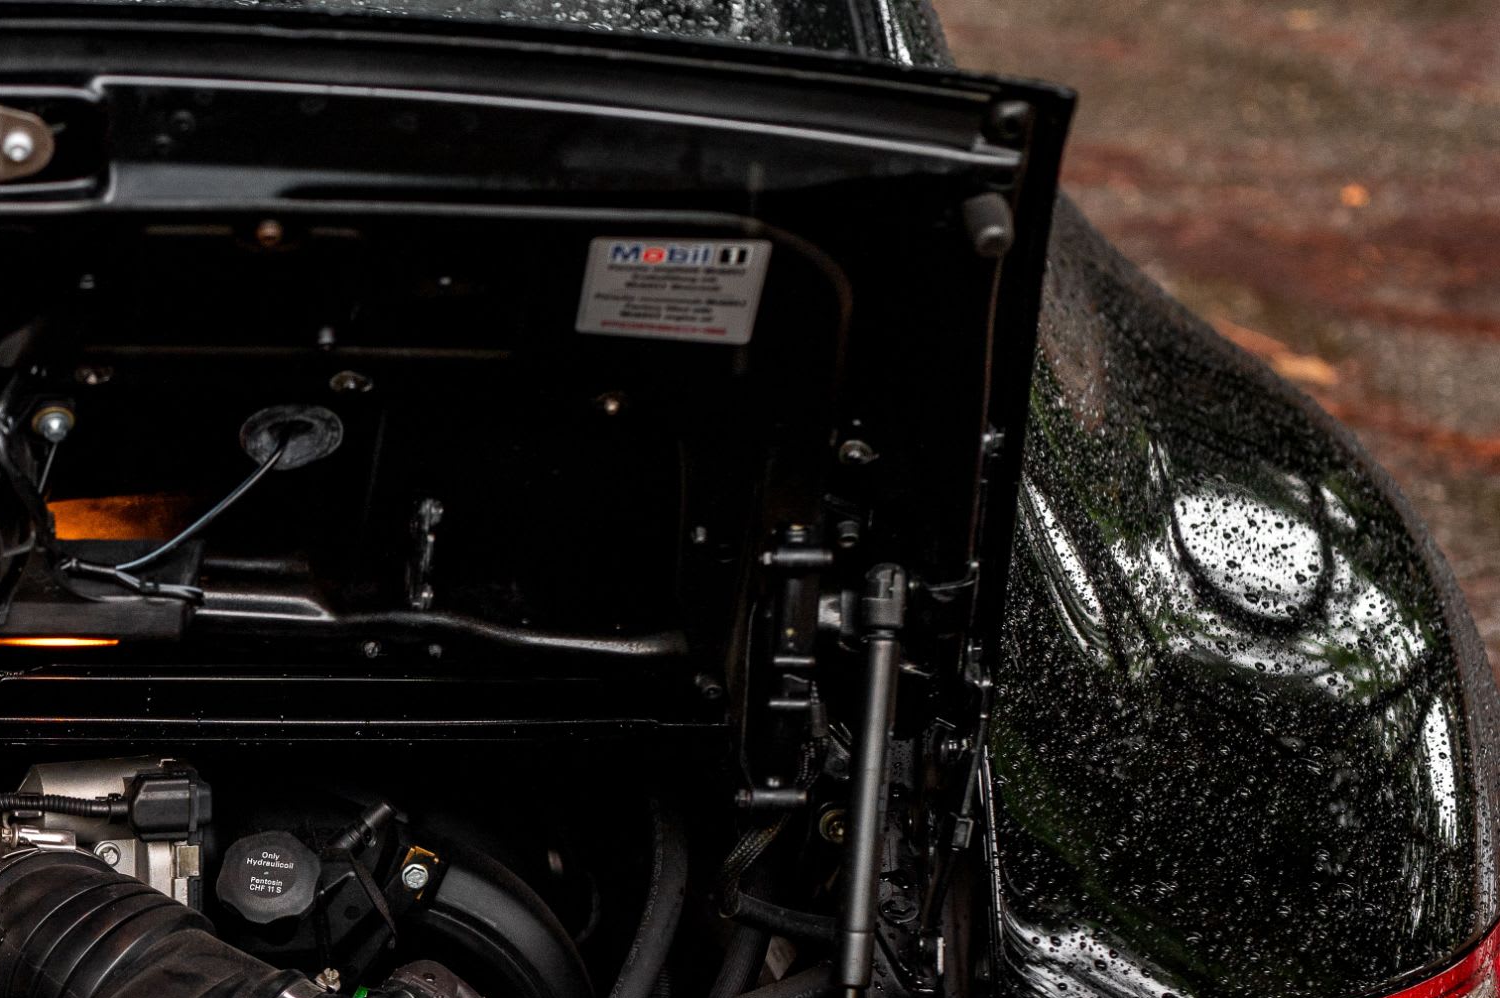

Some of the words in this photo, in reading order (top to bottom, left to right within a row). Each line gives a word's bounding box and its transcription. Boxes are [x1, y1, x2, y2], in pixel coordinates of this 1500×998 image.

[610, 244, 710, 265] Mobil
[261, 851, 280, 860] Only
[246, 858, 294, 870] Hydraulicoil
[250, 876, 283, 888] Pentosin
[249, 883, 265, 892] CHF
[276, 886, 282, 894] S
